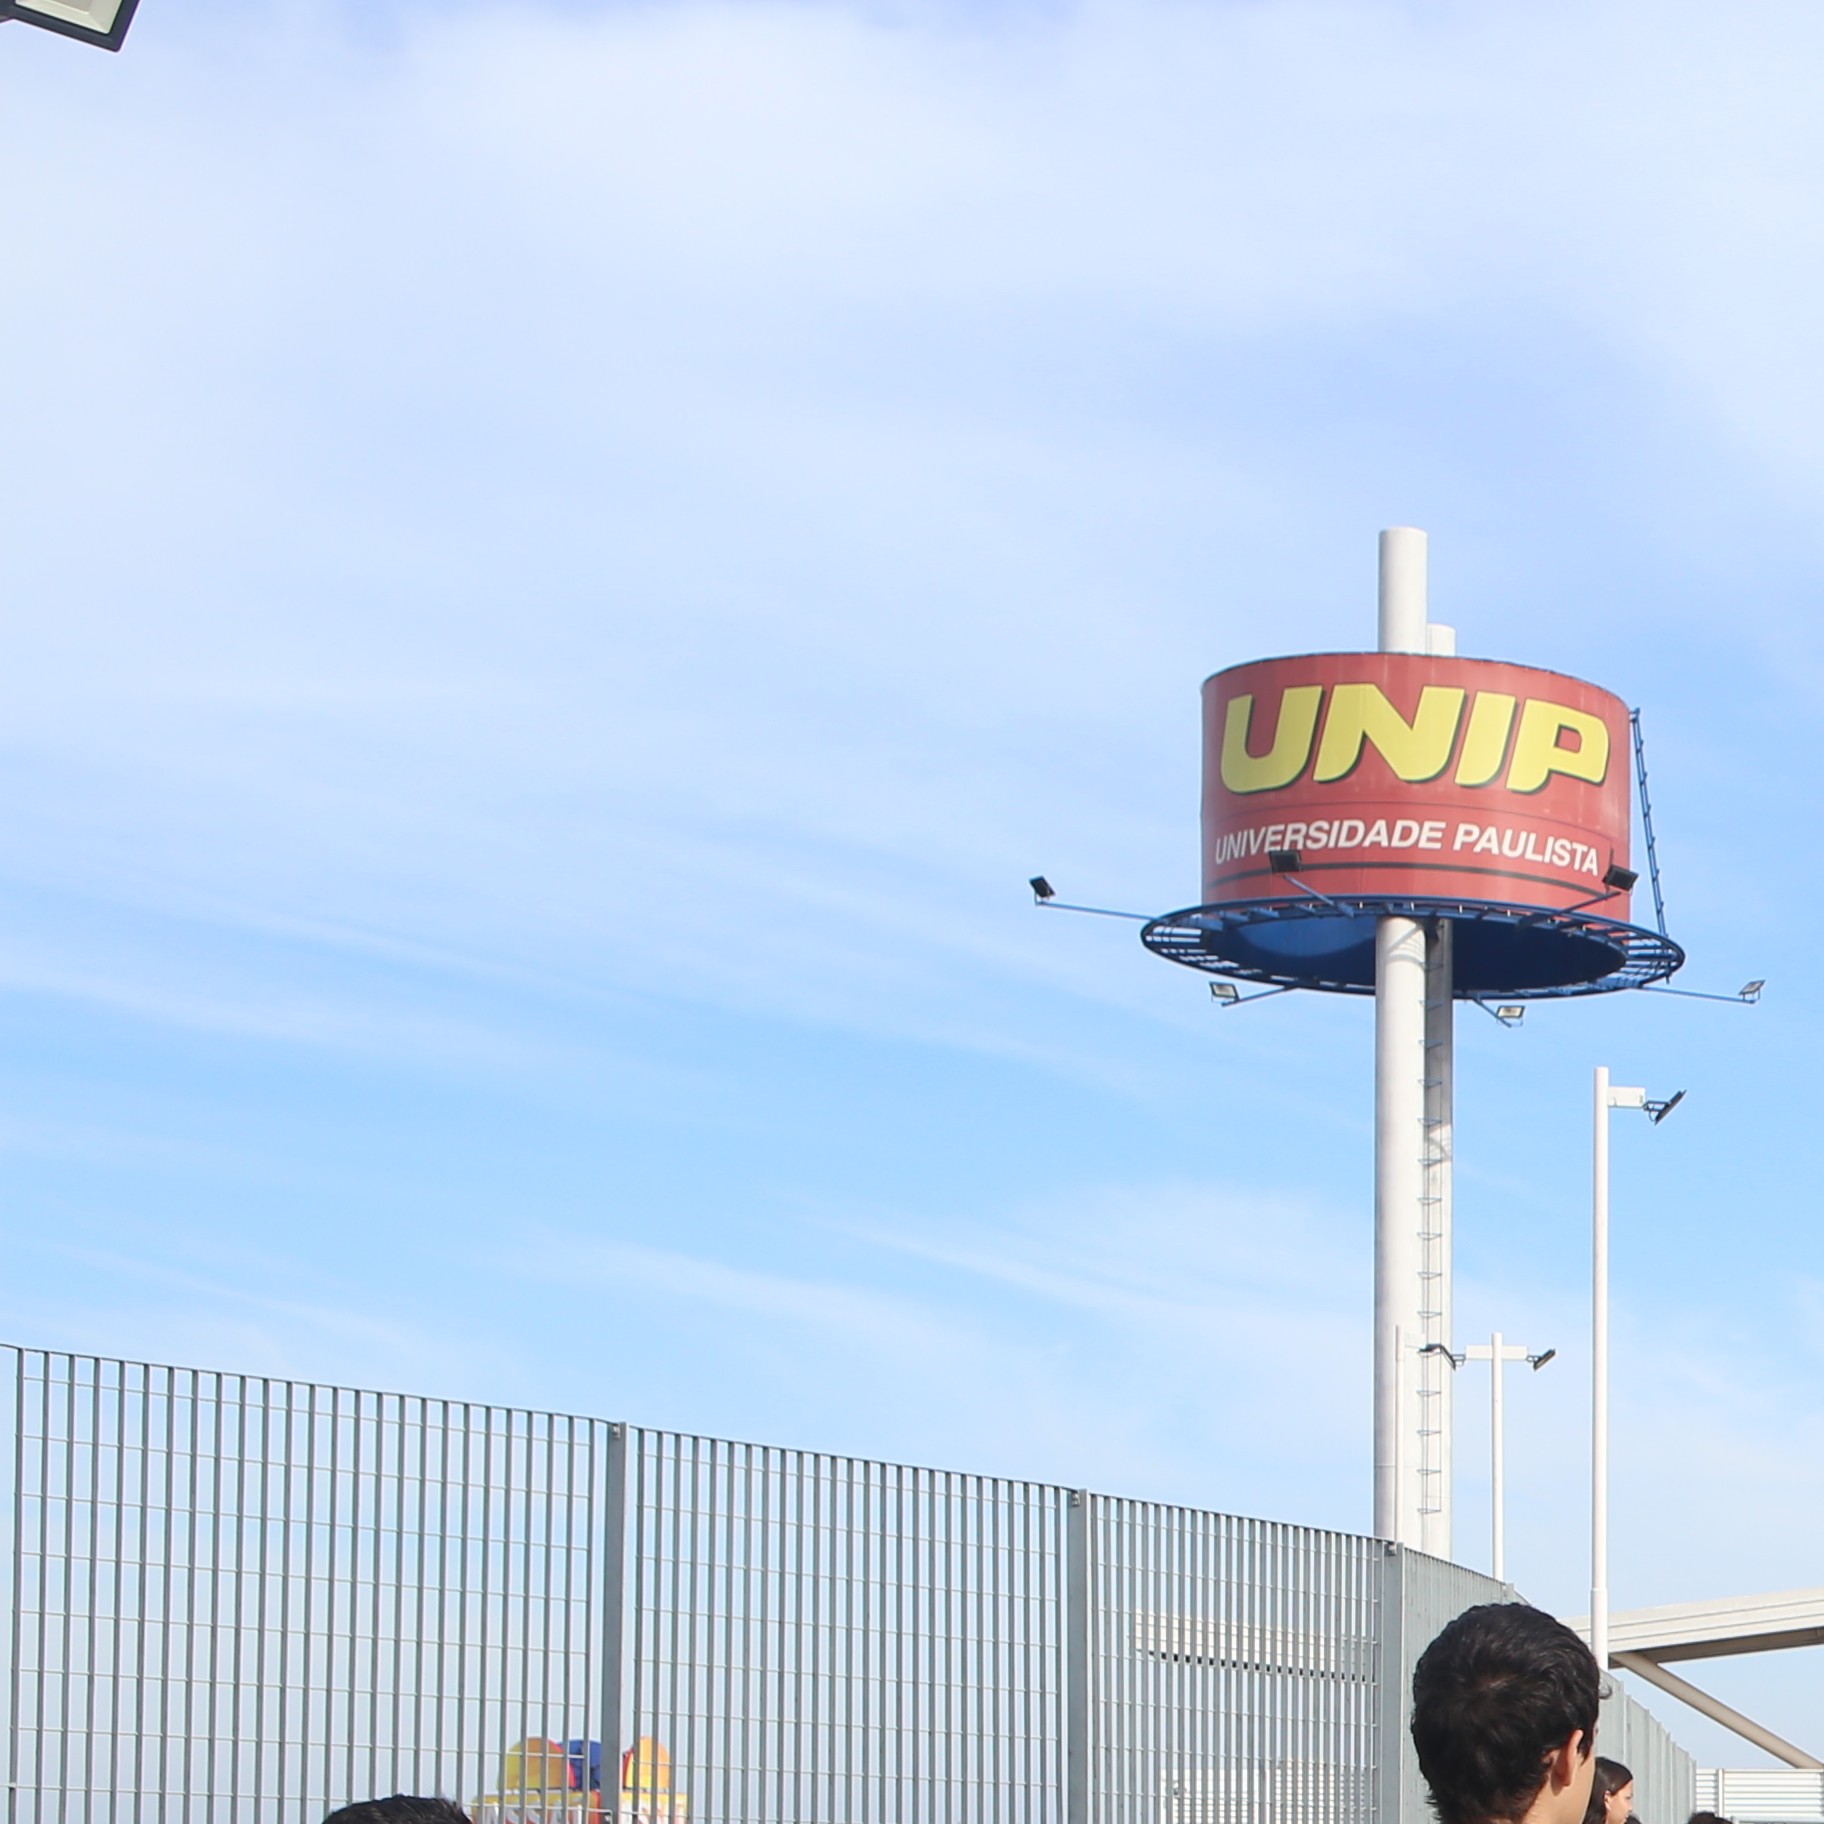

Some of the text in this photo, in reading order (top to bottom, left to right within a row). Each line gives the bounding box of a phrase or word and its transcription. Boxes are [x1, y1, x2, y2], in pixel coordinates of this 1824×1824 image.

[1219, 682, 1610, 794] UNIP
[1214, 818, 1599, 876] UNIVERSIDADE PAULISTA
